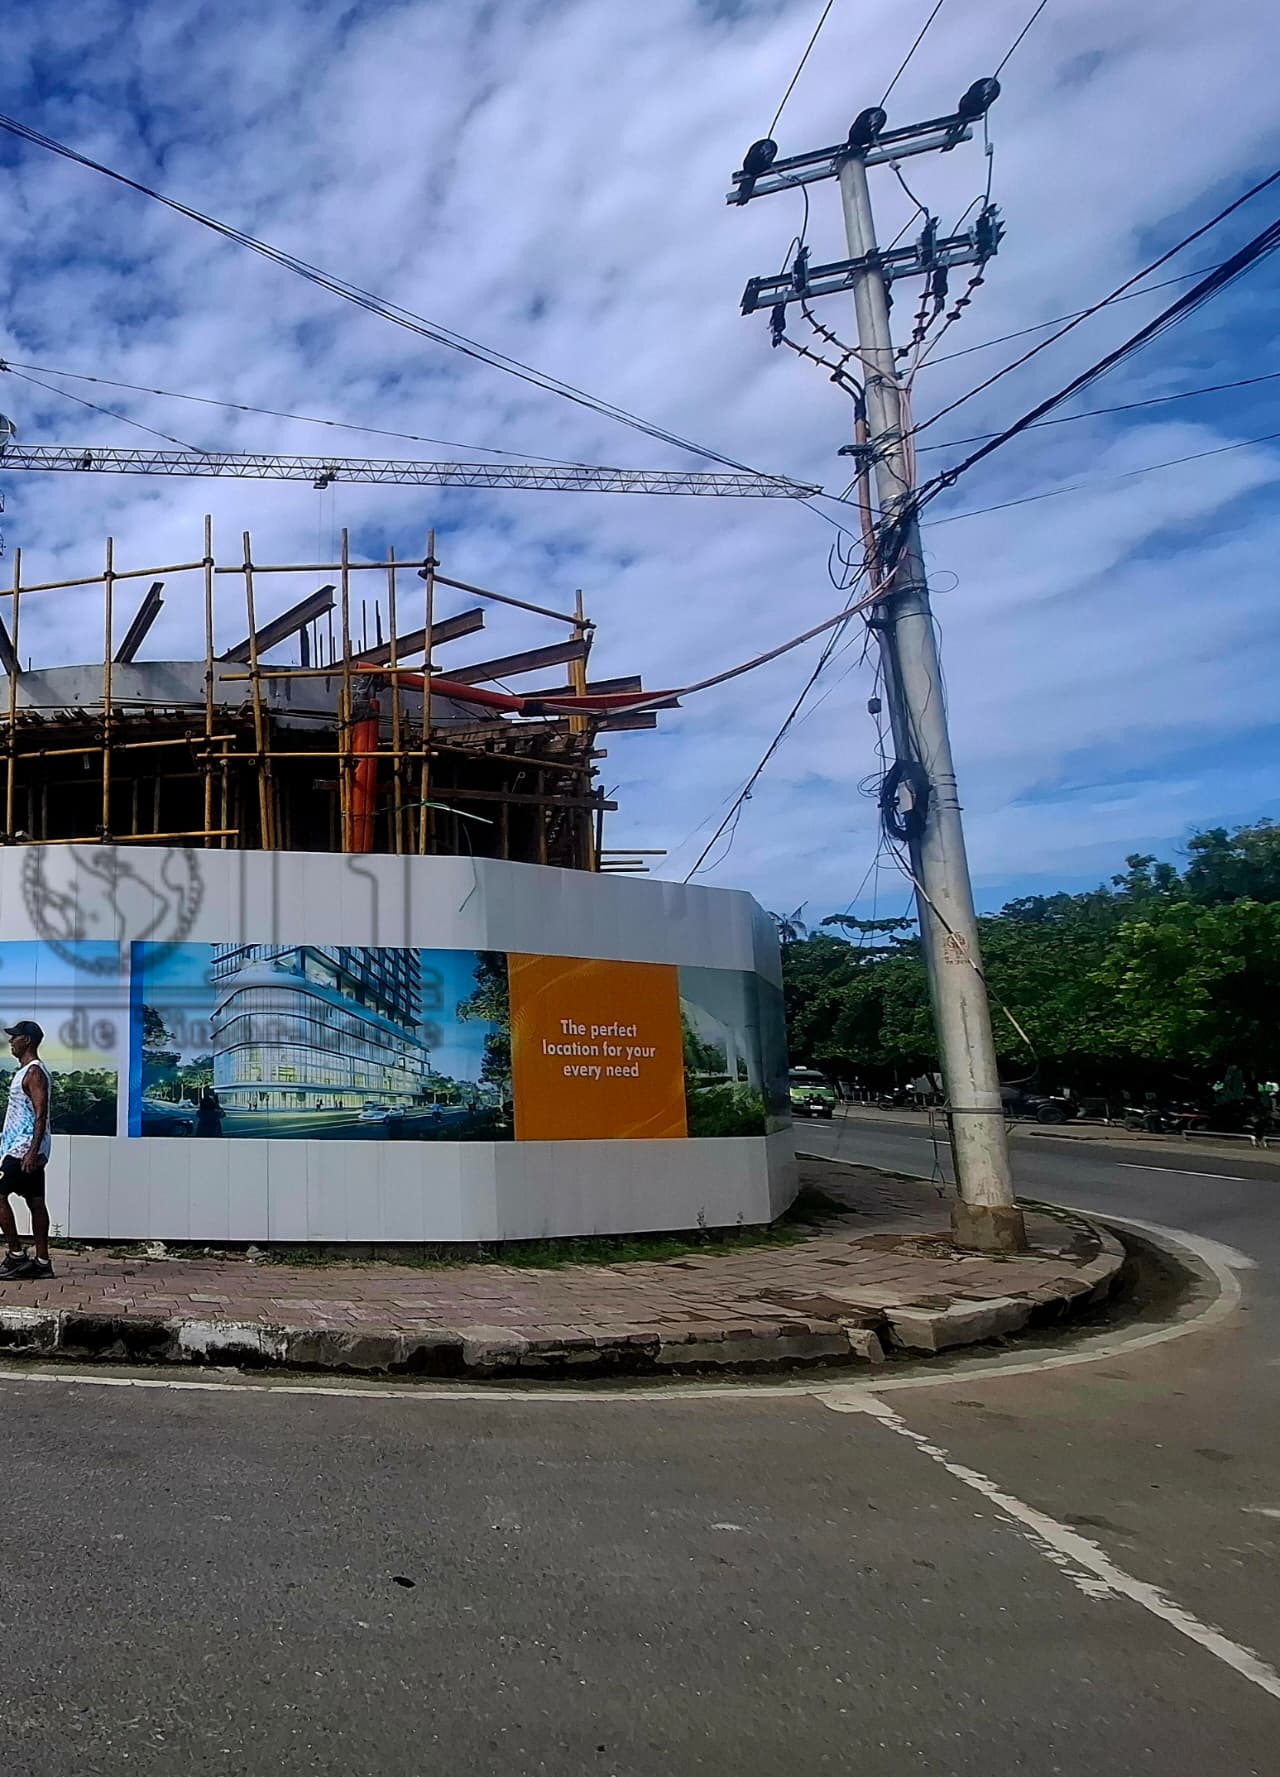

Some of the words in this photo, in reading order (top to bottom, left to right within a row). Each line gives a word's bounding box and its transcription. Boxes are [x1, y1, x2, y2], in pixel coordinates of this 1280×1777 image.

[560, 1019, 586, 1035] The
[591, 1022, 637, 1039] perfect
[542, 1039, 599, 1056] location
[603, 1041, 622, 1056] for
[625, 1045, 656, 1060] your
[563, 1064, 601, 1080] every
[606, 1062, 639, 1077] need
